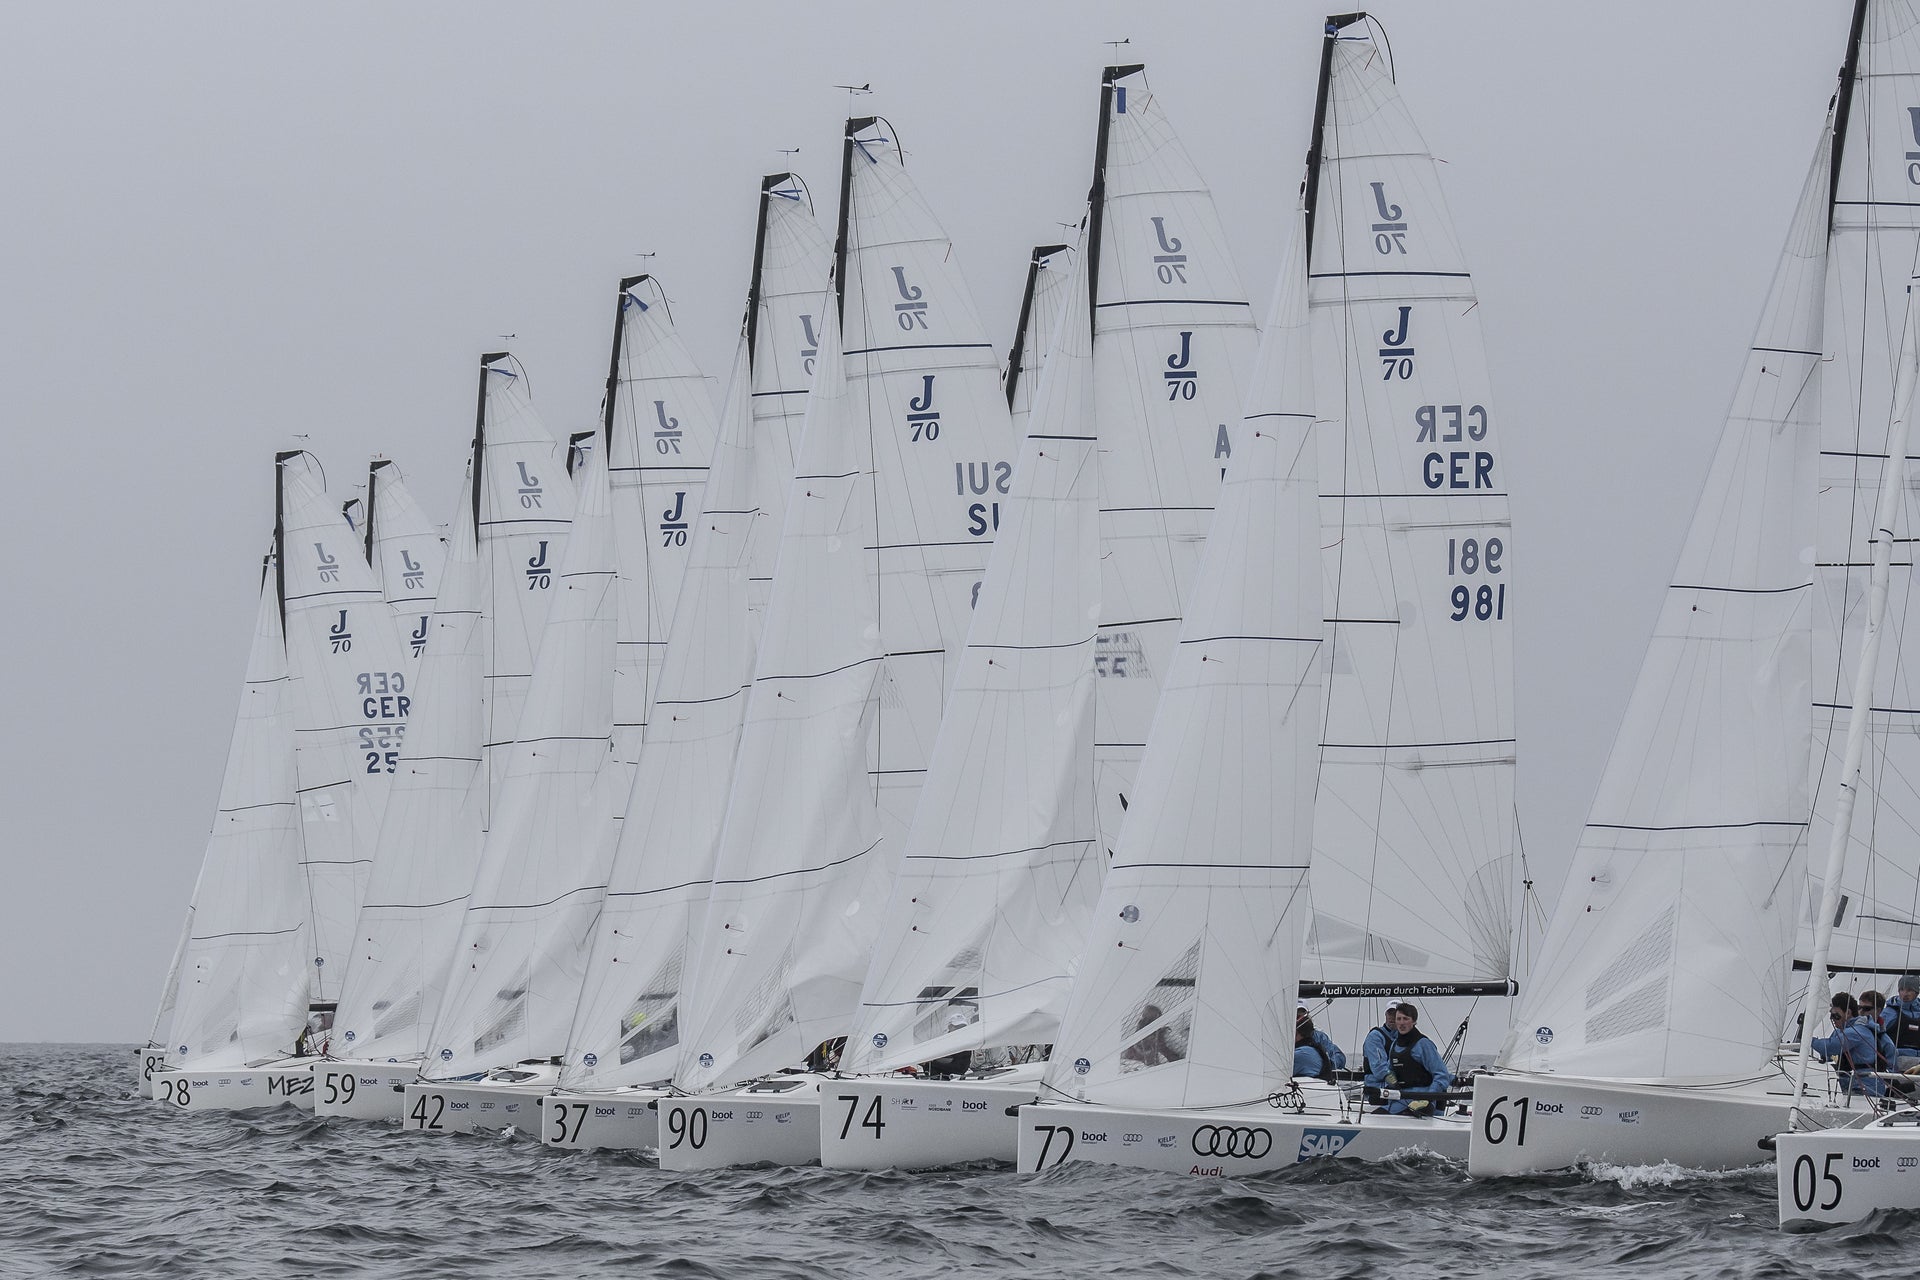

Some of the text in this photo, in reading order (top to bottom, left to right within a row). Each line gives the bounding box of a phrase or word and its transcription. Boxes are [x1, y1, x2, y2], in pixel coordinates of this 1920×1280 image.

[1382, 306, 1412, 346] J
[1167, 331, 1193, 369] J
[1382, 358, 1413, 380] 70
[909, 375, 936, 411] J
[1167, 380, 1197, 401] 70
[910, 421, 940, 442] 70
[1423, 452, 1494, 488] GER
[663, 492, 686, 521] J
[662, 530, 687, 547] 70
[528, 541, 548, 568] J
[528, 575, 550, 590] 70
[1450, 583, 1505, 622] 981
[331, 610, 347, 634] J
[412, 616, 428, 639] J
[331, 639, 351, 654] 70
[363, 696, 411, 718] GER
[1320, 985, 1455, 997] Audi Vorsprung durch Technik
[324, 1073, 356, 1104] 59
[360, 1077, 378, 1085] boot
[410, 1094, 445, 1129] 42
[450, 1101, 469, 1109] boot
[595, 1106, 616, 1116] boot
[712, 1110, 733, 1120] boot
[962, 1100, 987, 1110] boot
[1536, 1101, 1564, 1113] boot
[551, 1103, 589, 1143] 37
[668, 1107, 708, 1150] 90
[838, 1095, 886, 1140] 74
[1484, 1095, 1529, 1146] 61
[1082, 1131, 1108, 1142] boot
[1301, 1134, 1345, 1156] SAP
[1034, 1125, 1075, 1173] 72
[1189, 1165, 1223, 1177] Audi
[1852, 1156, 1880, 1168] boot
[1793, 1152, 1843, 1212] 05
